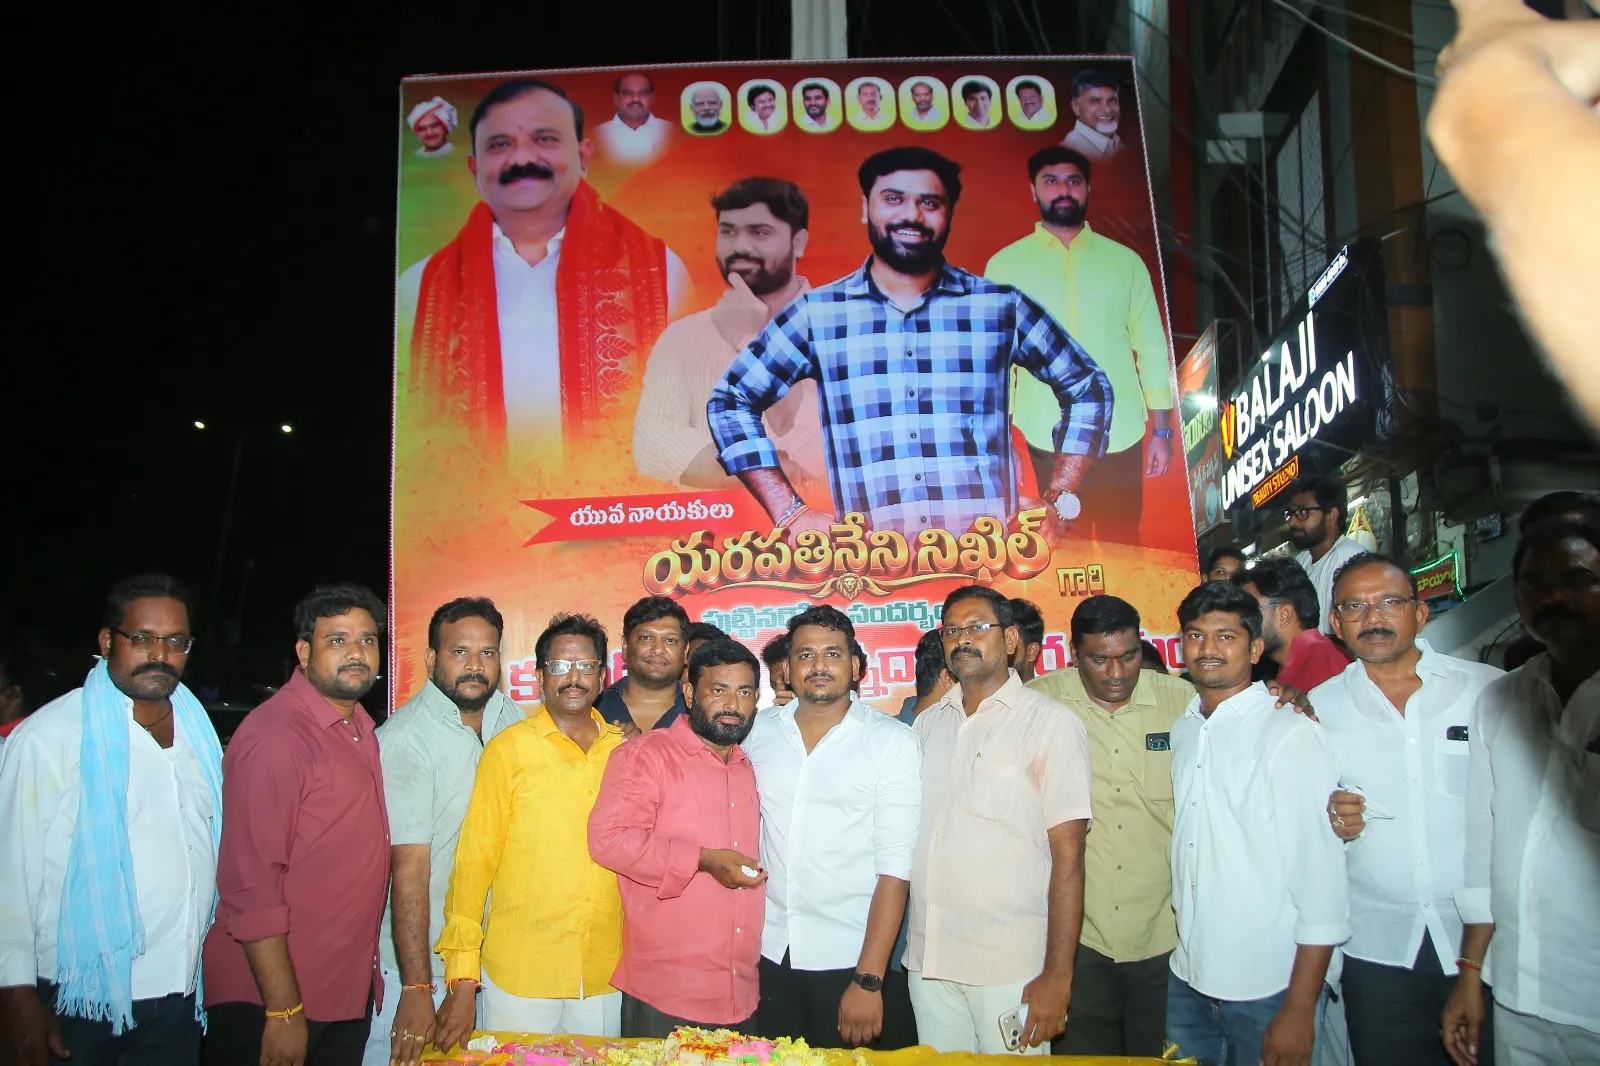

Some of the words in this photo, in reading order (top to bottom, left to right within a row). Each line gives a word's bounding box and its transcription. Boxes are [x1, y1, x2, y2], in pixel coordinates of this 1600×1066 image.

[1221, 430, 1273, 511] UNISEX
[1273, 350, 1356, 467] SALOON
[1235, 310, 1317, 448] BALAJI
[569, 502, 626, 526] యువ
[628, 498, 735, 523] నాయకులు
[643, 511, 911, 597] యరపతినేని
